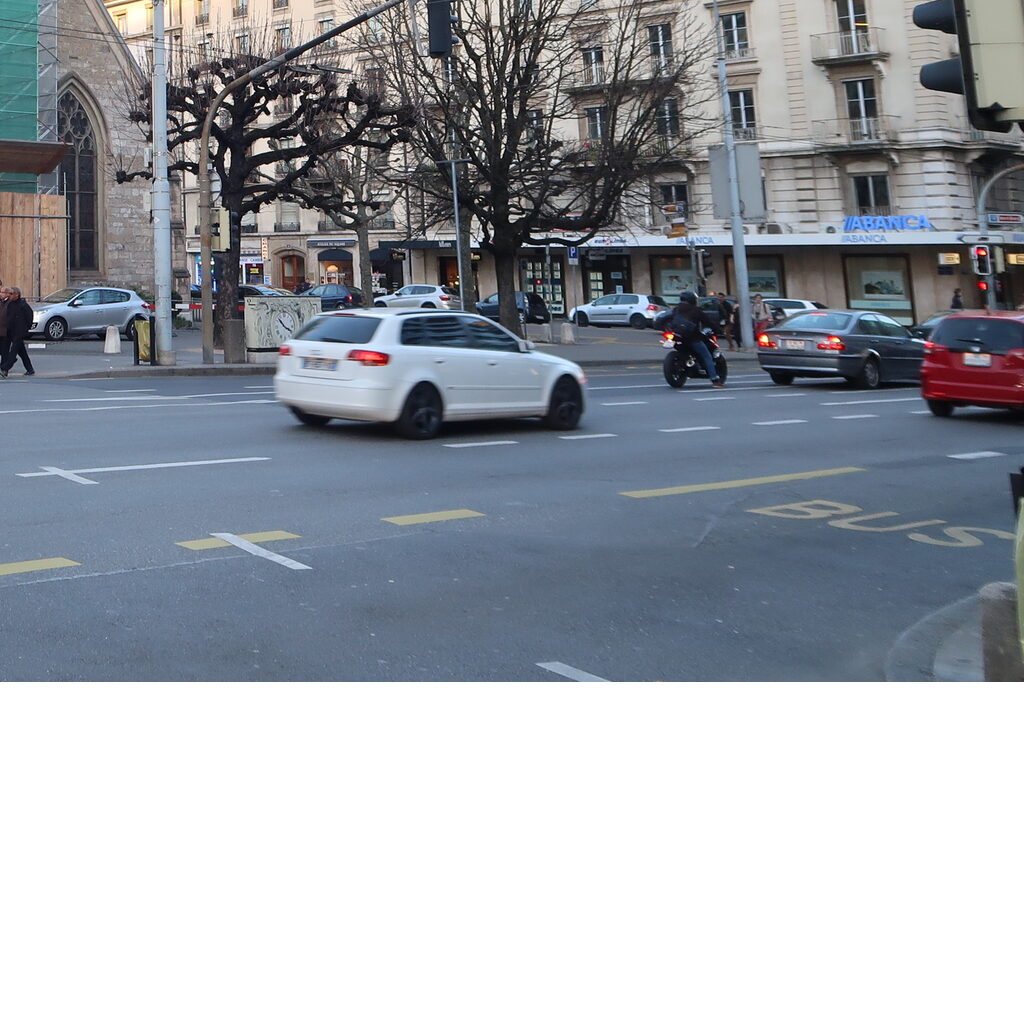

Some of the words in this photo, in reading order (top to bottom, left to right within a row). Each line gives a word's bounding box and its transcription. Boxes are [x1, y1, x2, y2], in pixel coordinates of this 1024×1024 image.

[845, 215, 935, 231] ABANCA
[843, 234, 887, 243] ABANCA
[570, 247, 576, 257] P
[744, 499, 1017, 547] BUS
